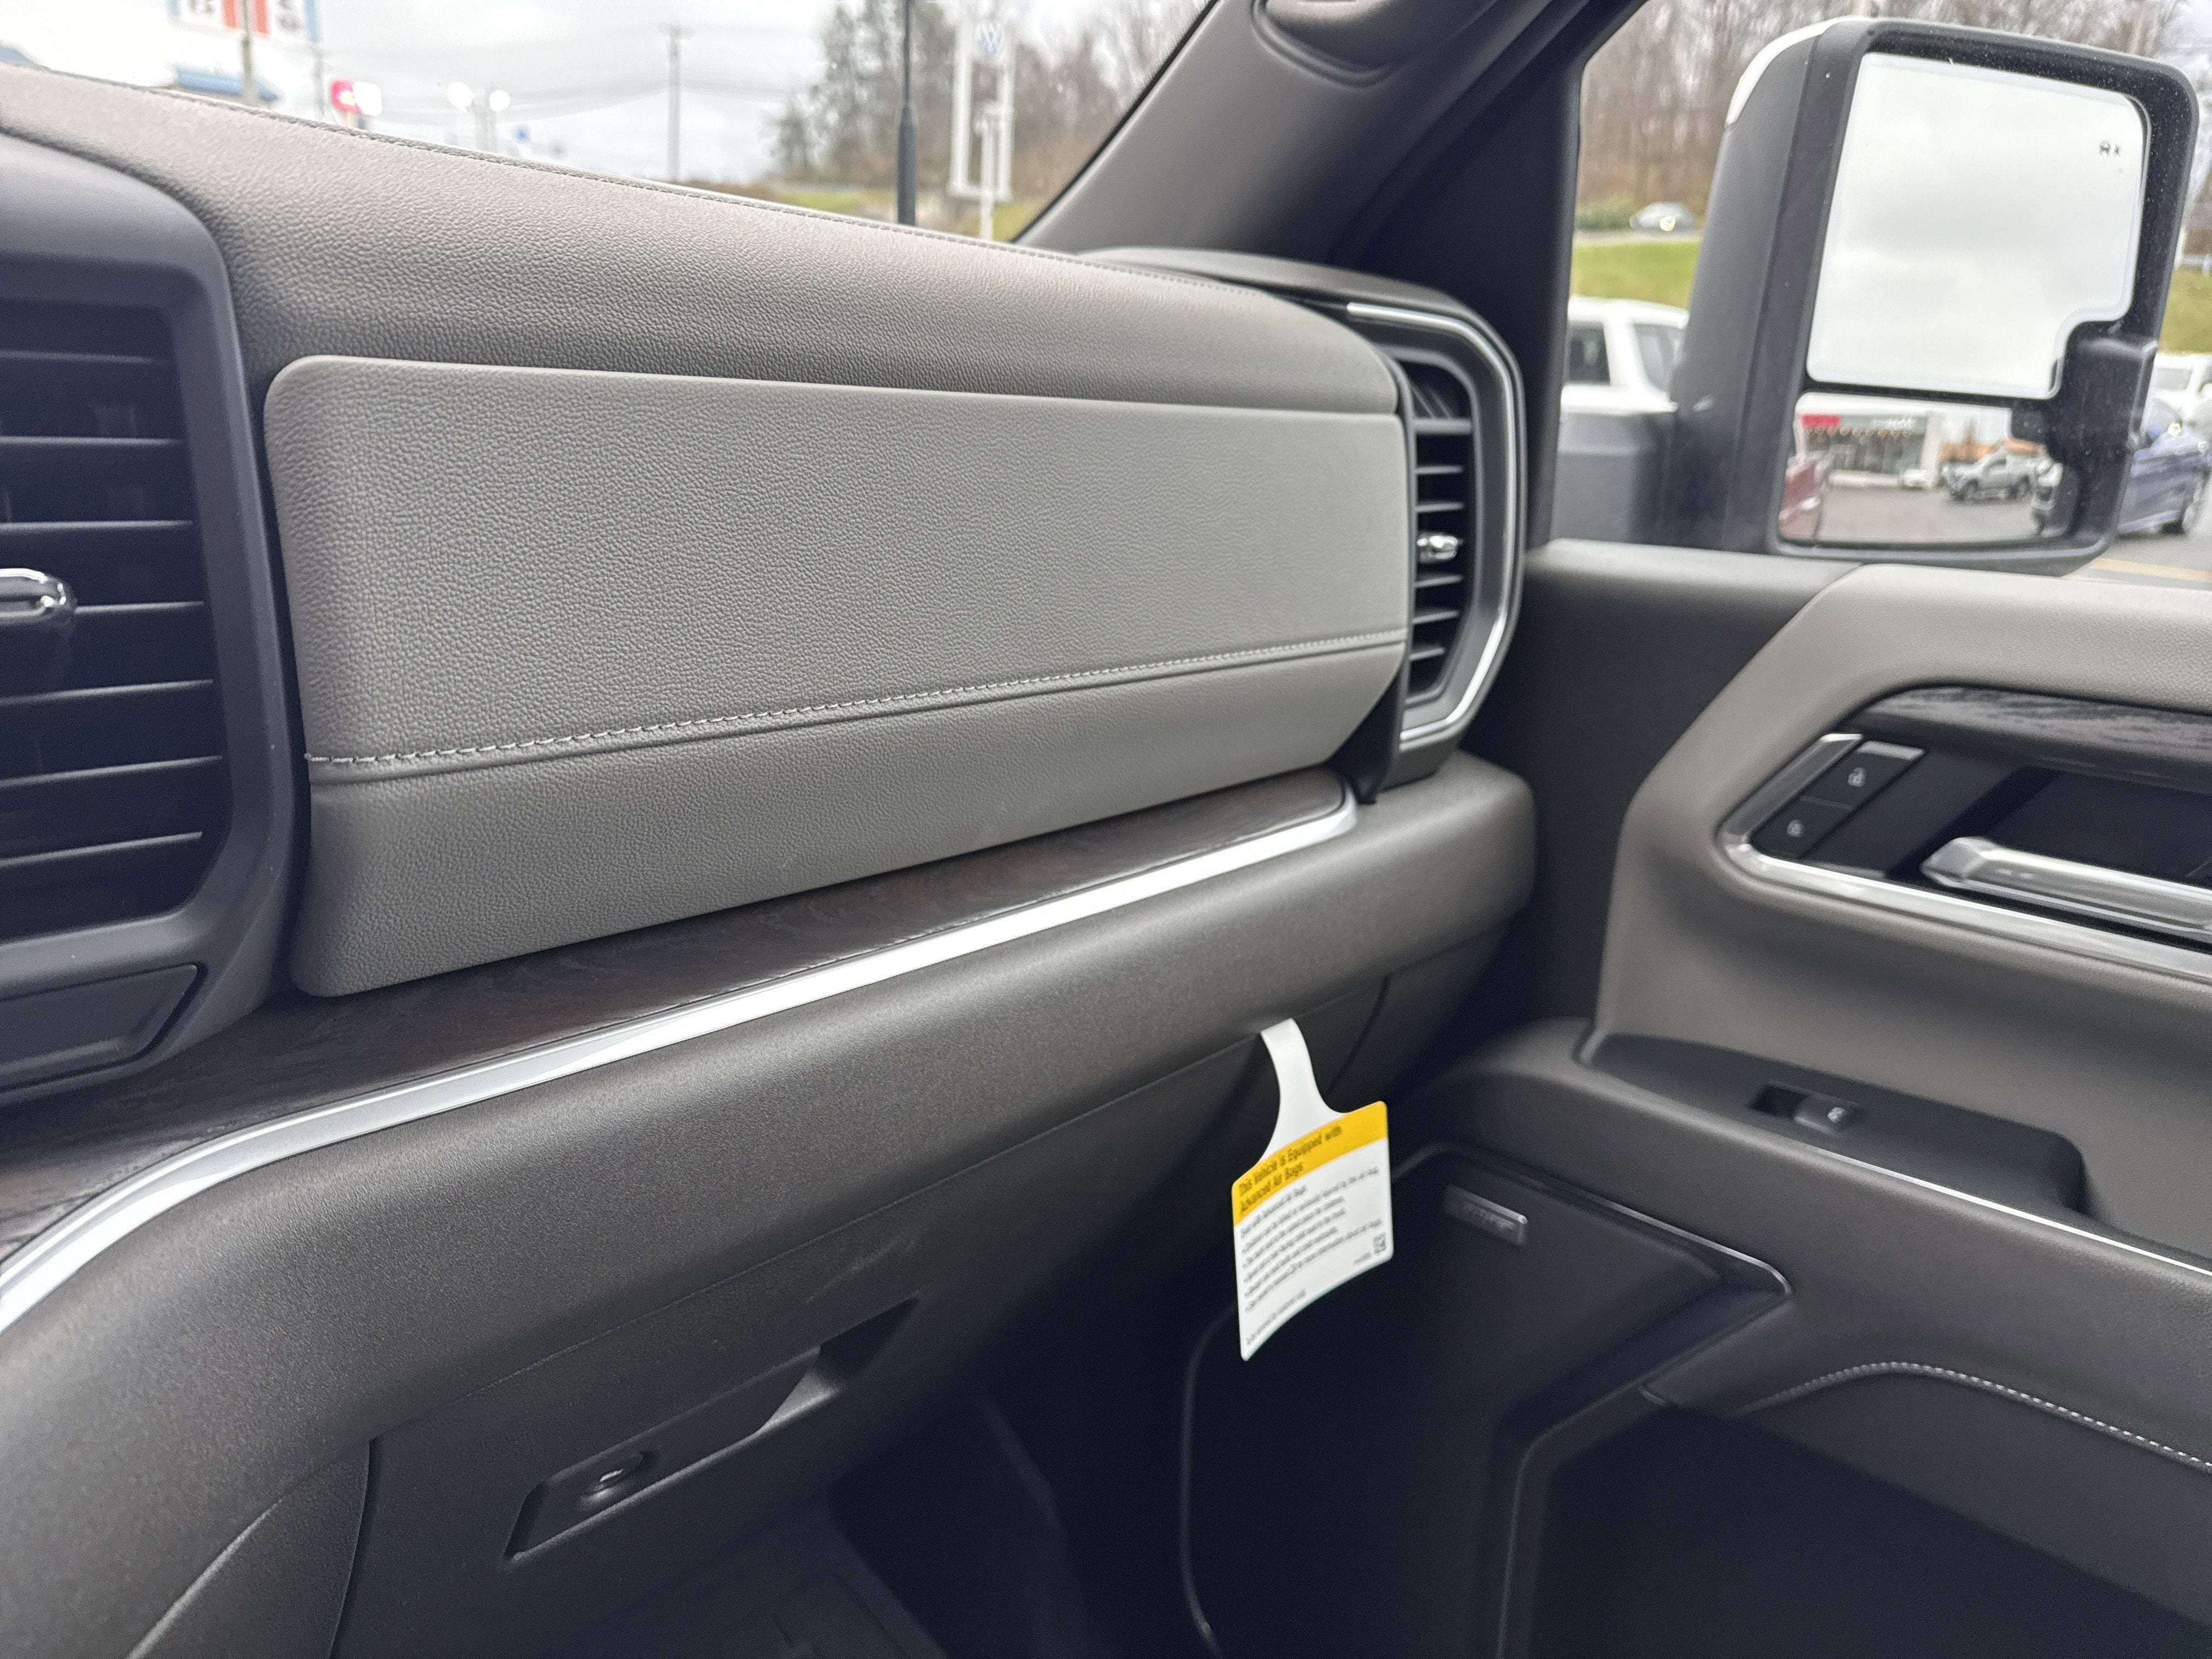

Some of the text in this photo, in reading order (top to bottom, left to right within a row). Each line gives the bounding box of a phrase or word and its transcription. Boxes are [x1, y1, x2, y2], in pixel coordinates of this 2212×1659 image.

[1239, 1179, 1252, 1196] This
[1288, 1134, 1322, 1161] Equipped
[1325, 1126, 1341, 1141] with
[1240, 1161, 1303, 1212] Advanced Air Bags
